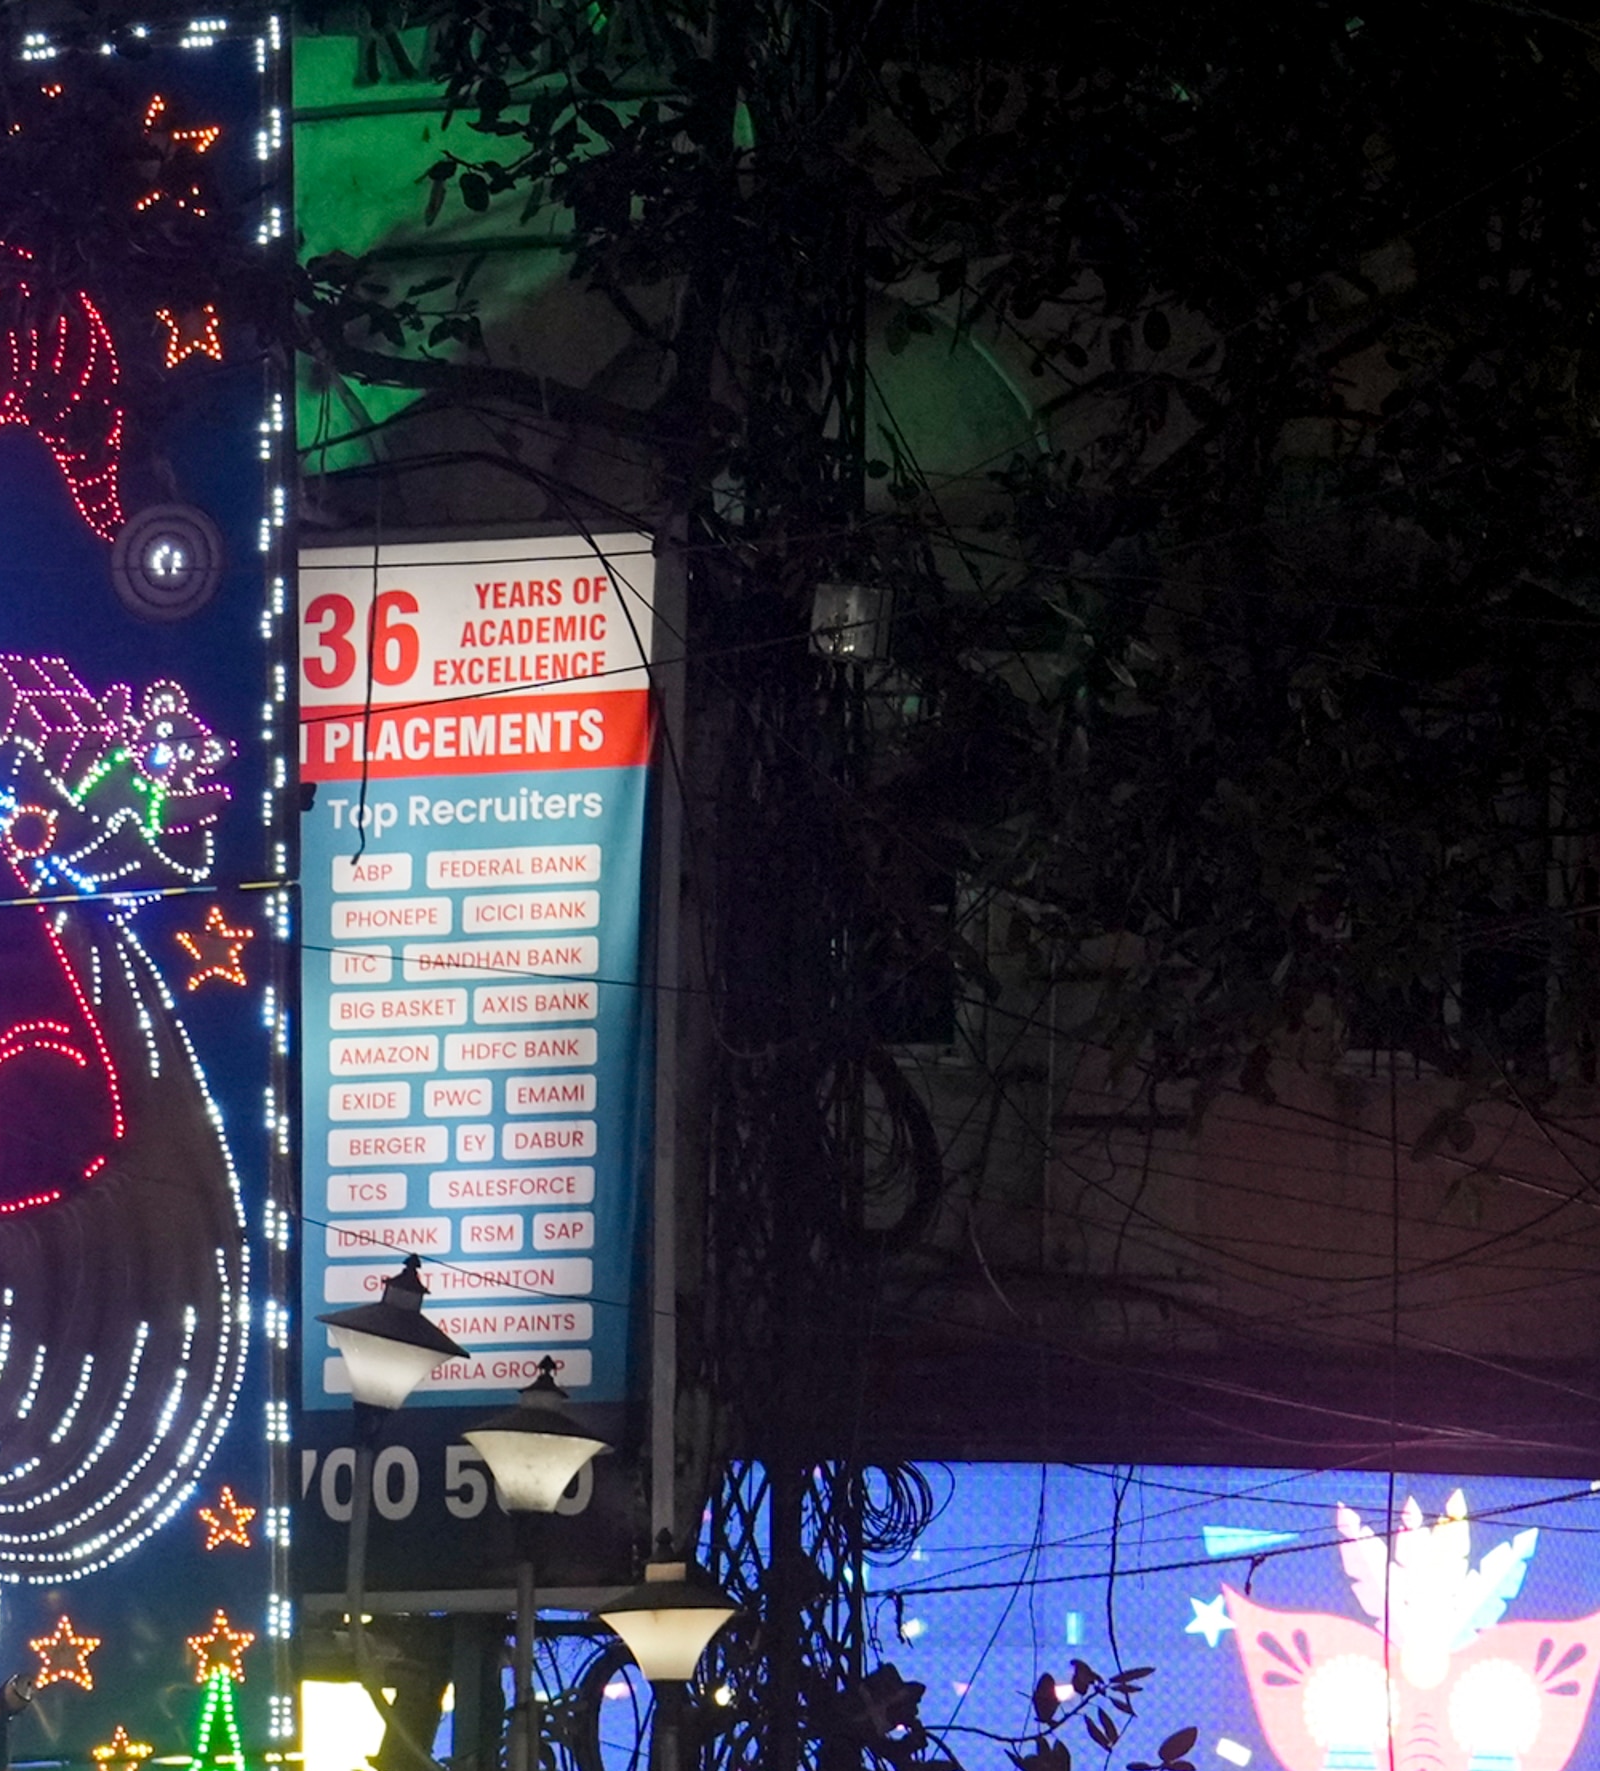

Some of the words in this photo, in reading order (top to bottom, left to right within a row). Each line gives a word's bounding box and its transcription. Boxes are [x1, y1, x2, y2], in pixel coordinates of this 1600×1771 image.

[475, 578, 562, 610] YEARS
[573, 576, 608, 604] OF
[303, 589, 419, 690] 36
[460, 613, 607, 648] ACADEMIC
[433, 651, 606, 687] EXCELLENCE
[324, 709, 603, 763] PLACEMENTS
[327, 798, 398, 839] Top
[408, 787, 603, 827] Recruiters
[353, 863, 392, 882] ABP
[439, 859, 525, 879] FEDERAL
[531, 855, 587, 875] BANK
[345, 908, 438, 929] PHONEPE
[475, 904, 525, 923] ICICI
[531, 901, 586, 921] BANK
[344, 954, 377, 974] ITC
[419, 951, 521, 972] BANDHAN
[528, 947, 583, 967] BANK
[340, 1001, 375, 1020] BIG
[382, 998, 456, 1018] BASKET
[482, 995, 528, 1014] AXIS
[535, 992, 590, 1012] BANK
[340, 1045, 430, 1065] AMAZON
[462, 1041, 517, 1061] HDFC
[524, 1038, 579, 1058] BANK
[342, 1091, 397, 1111] EXIDE
[433, 1088, 483, 1107] PWC
[517, 1084, 585, 1104] EMAMI
[349, 1136, 426, 1156] BERGER
[463, 1133, 486, 1152] EY
[514, 1130, 584, 1150] DABUR
[348, 1182, 387, 1201] TCS
[448, 1176, 576, 1198] SALESFORCE
[338, 1229, 376, 1247] IDBI
[383, 1226, 438, 1246] BANK
[470, 1224, 514, 1242] RSM
[543, 1221, 584, 1241] SAP
[442, 1268, 555, 1290] THORNTON
[438, 1315, 497, 1335] ASIAN
[504, 1312, 575, 1332] PAINTS
[431, 1359, 486, 1380] BIRLA
[492, 1359, 565, 1379] GROP
